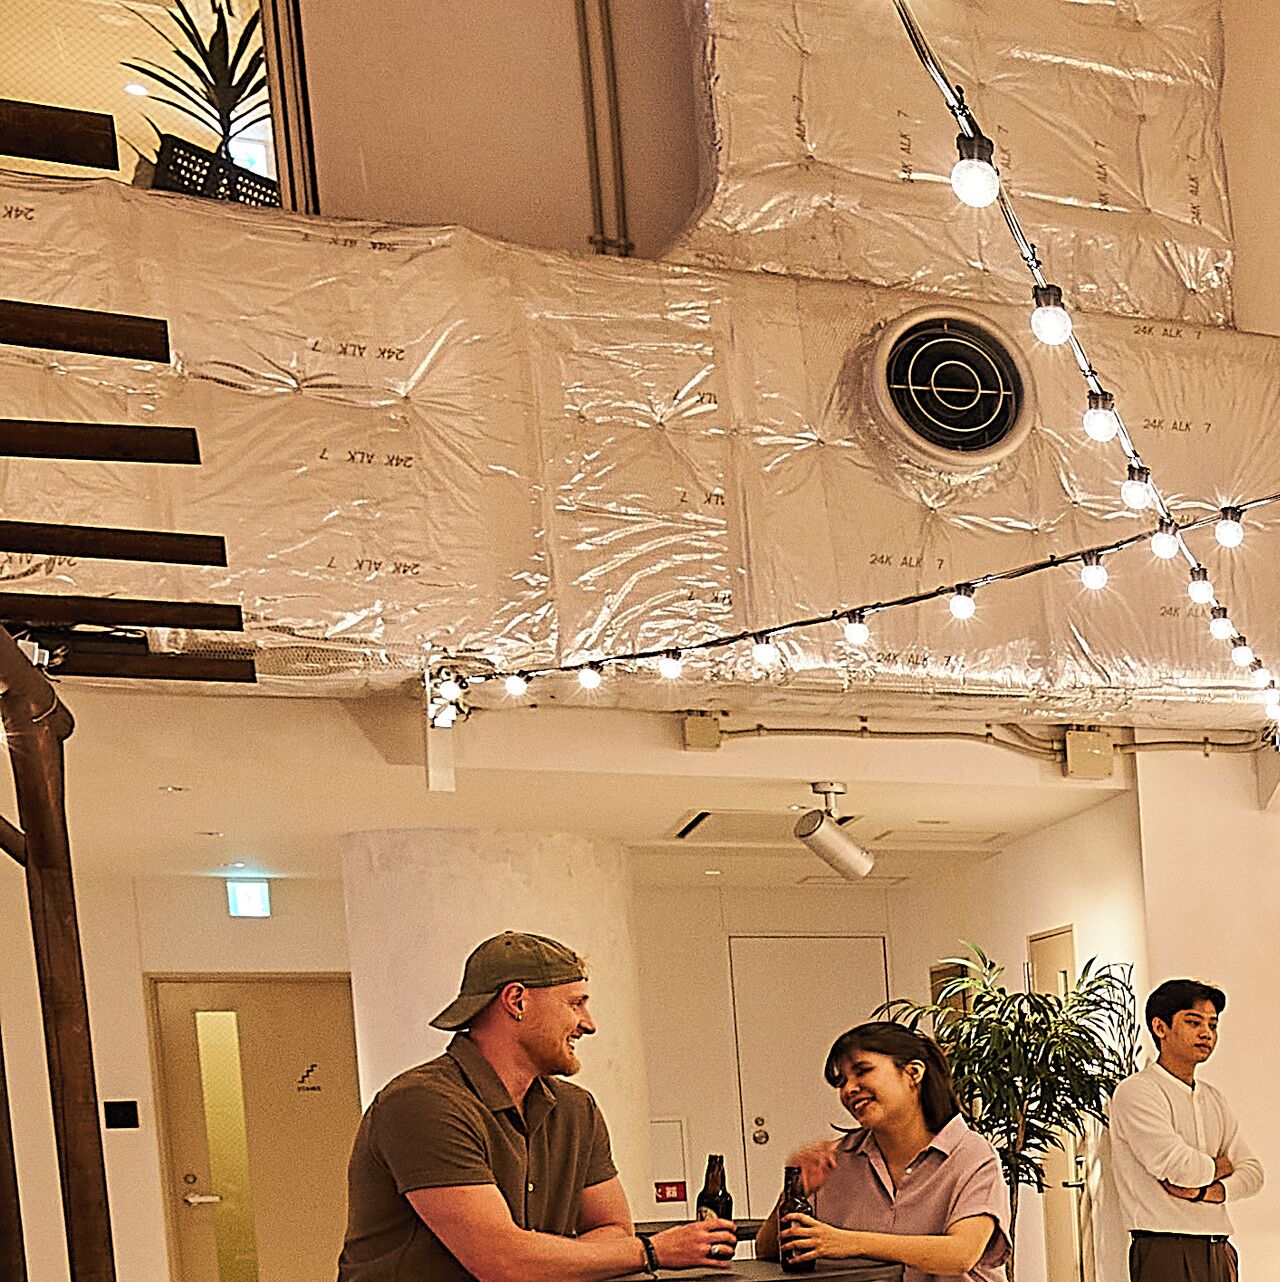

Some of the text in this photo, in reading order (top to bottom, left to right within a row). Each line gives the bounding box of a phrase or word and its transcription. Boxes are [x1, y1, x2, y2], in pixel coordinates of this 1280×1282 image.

[899, 130, 911, 155] ALK
[1187, 154, 1197, 162] 7
[1096, 161, 1107, 184] ALK
[1189, 174, 1200, 196] ALK
[3, 205, 35, 221] 24K
[1134, 325, 1202, 340] 24K ALK 7
[311, 340, 405, 361] 24K ALK 7
[1143, 419, 1212, 433] 24K ALK 7
[319, 447, 414, 468] 24K ALK 7
[680, 491, 688, 503] 7
[327, 556, 421, 575] 24K ALK 7
[869, 553, 944, 570] 24K ALK 7
[1160, 606, 1181, 617] 24K
[876, 652, 900, 665] 24K
[908, 653, 930, 666] ALK
